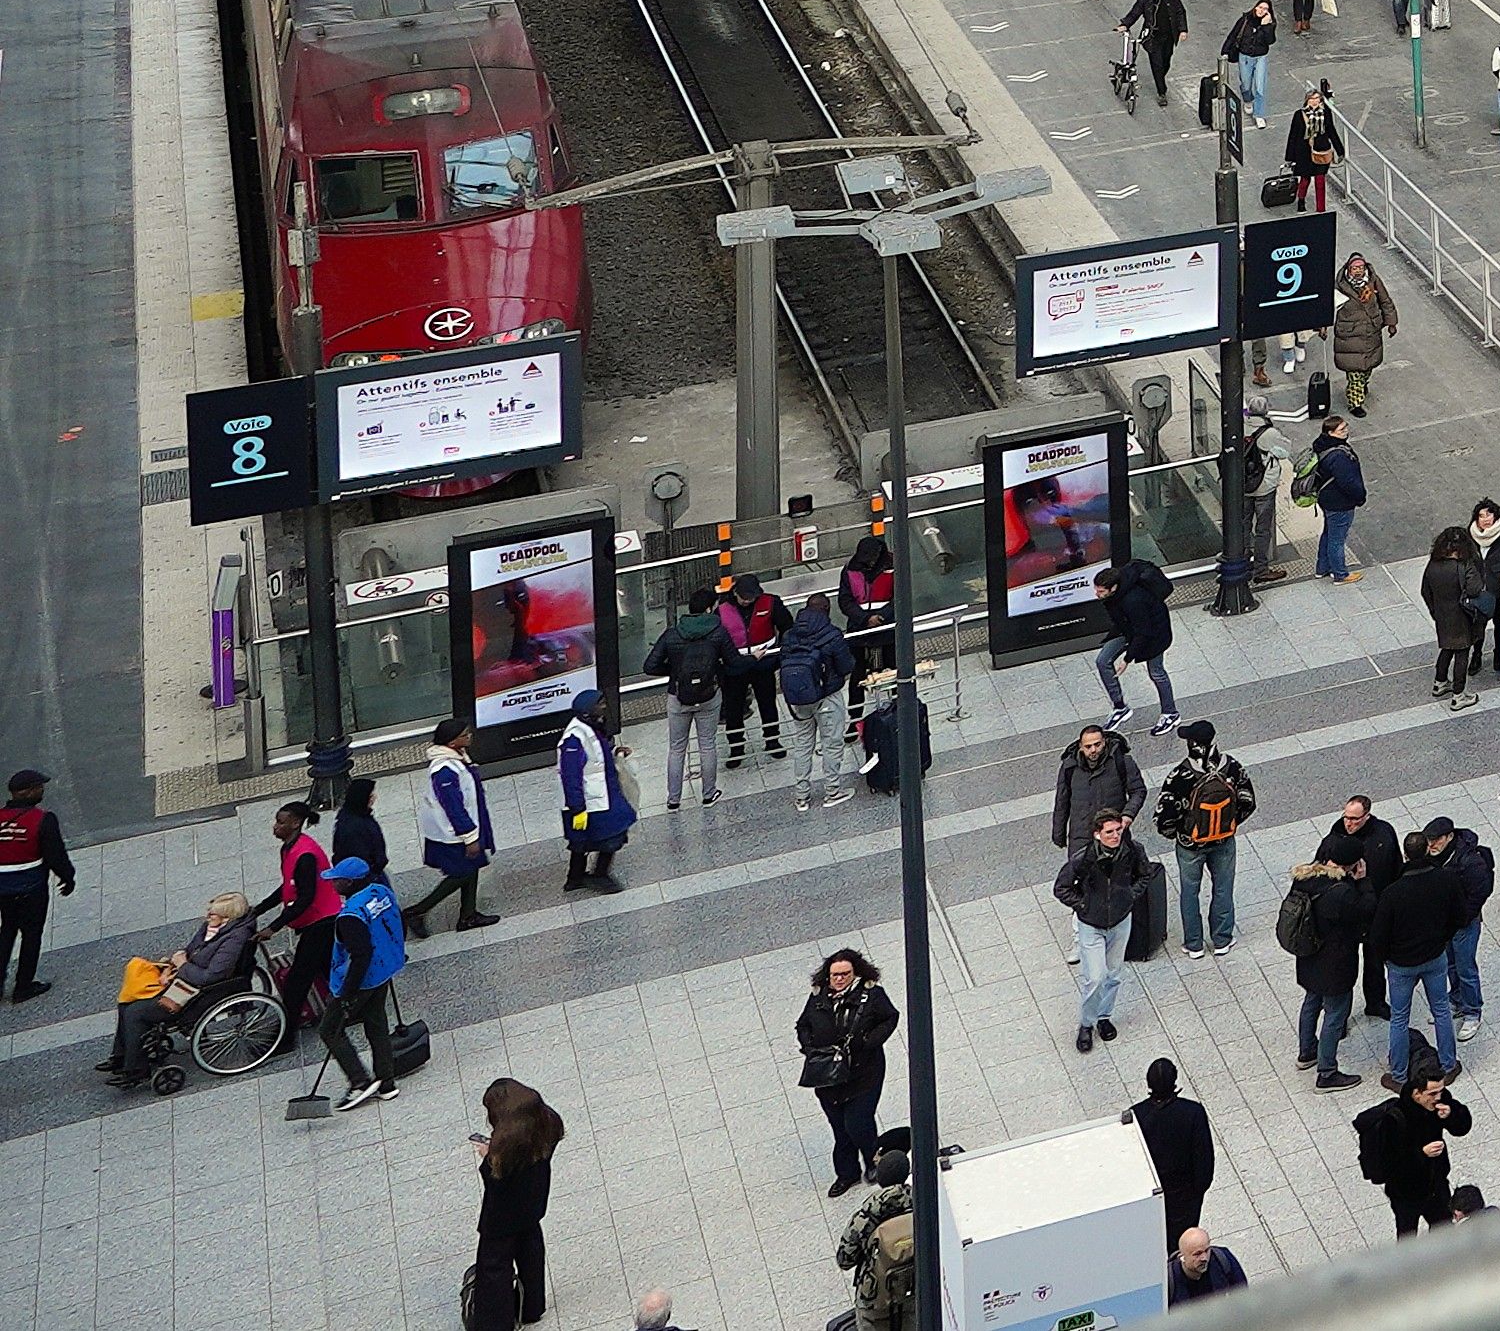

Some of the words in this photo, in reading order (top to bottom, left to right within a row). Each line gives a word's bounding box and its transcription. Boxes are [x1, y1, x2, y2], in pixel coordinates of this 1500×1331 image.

[1275, 248, 1304, 260] Voie
[1049, 265, 1109, 283] Attentifs
[1113, 256, 1172, 273] ensemble
[1276, 262, 1303, 298] 9
[357, 378, 428, 399] Attentifs
[434, 367, 504, 387] ensemble
[228, 417, 265, 433] Voie
[231, 436, 267, 475] 8
[1028, 445, 1083, 464] DEADPOOL
[500, 542, 564, 563] DEADPOOL
[1030, 587, 1056, 599] ACHAT
[1058, 580, 1090, 594] DIGITAL
[502, 694, 532, 709] ACHAT
[535, 687, 572, 702] DIGITAL
[1060, 1311, 1092, 1329] TAXI
